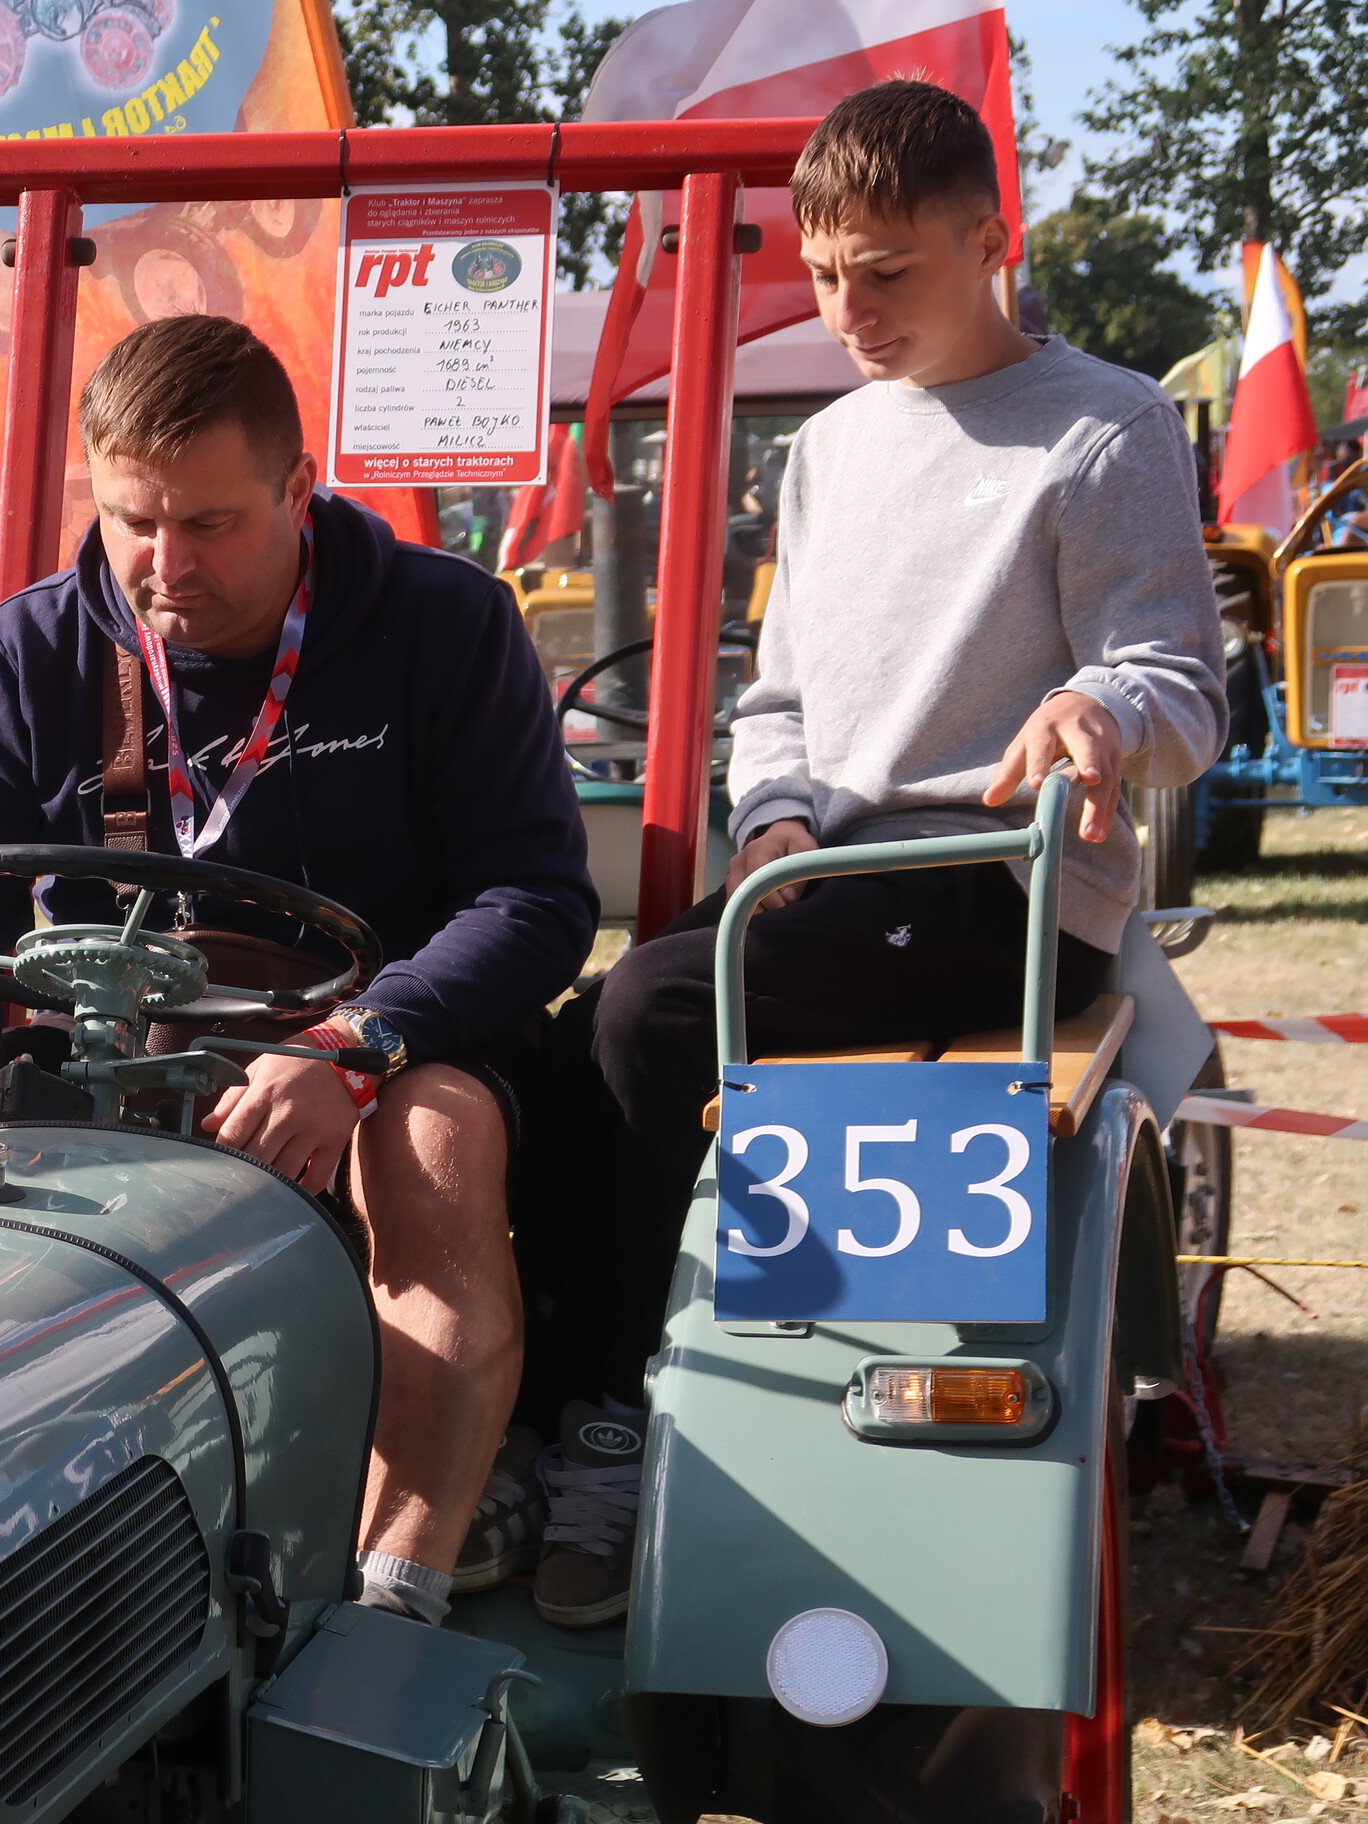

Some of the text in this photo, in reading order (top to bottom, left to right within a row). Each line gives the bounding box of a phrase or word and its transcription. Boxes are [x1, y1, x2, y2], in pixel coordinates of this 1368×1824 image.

[368, 199, 386, 207] Klub
[469, 196, 503, 205] zaprasza
[368, 209, 377, 217] do
[380, 208, 417, 218] oglądania
[425, 207, 460, 216] zbierania
[367, 218, 396, 228] starych
[397, 217, 437, 228] ciągników
[444, 217, 474, 226] maszyn
[476, 215, 516, 225] rolniczych
[355, 243, 436, 298] rpt
[423, 299, 539, 314] EICHER PANTHER
[359, 308, 415, 318] marka pojazdu
[443, 318, 480, 332] 1963
[372, 328, 408, 337] produkcji
[357, 346, 421, 356] kraj pochodzenia
[439, 339, 491, 354] NIEMCY
[356, 366, 397, 375] pojemność
[436, 358, 469, 372] 1689
[355, 385, 406, 394] rodzaj paliwa
[445, 376, 495, 391] DIESEL
[456, 396, 466, 407] 2
[378, 404, 415, 413] cylindrów
[424, 415, 462, 428] PAWEŁ
[437, 434, 486, 447] MILICZ
[353, 442, 401, 452] miejscowość
[364, 455, 514, 470] więcej o starych traktorach
[363, 471, 371, 479] w
[413, 469, 454, 480] Przeglądzie
[727, 1118, 1034, 1259] 353
